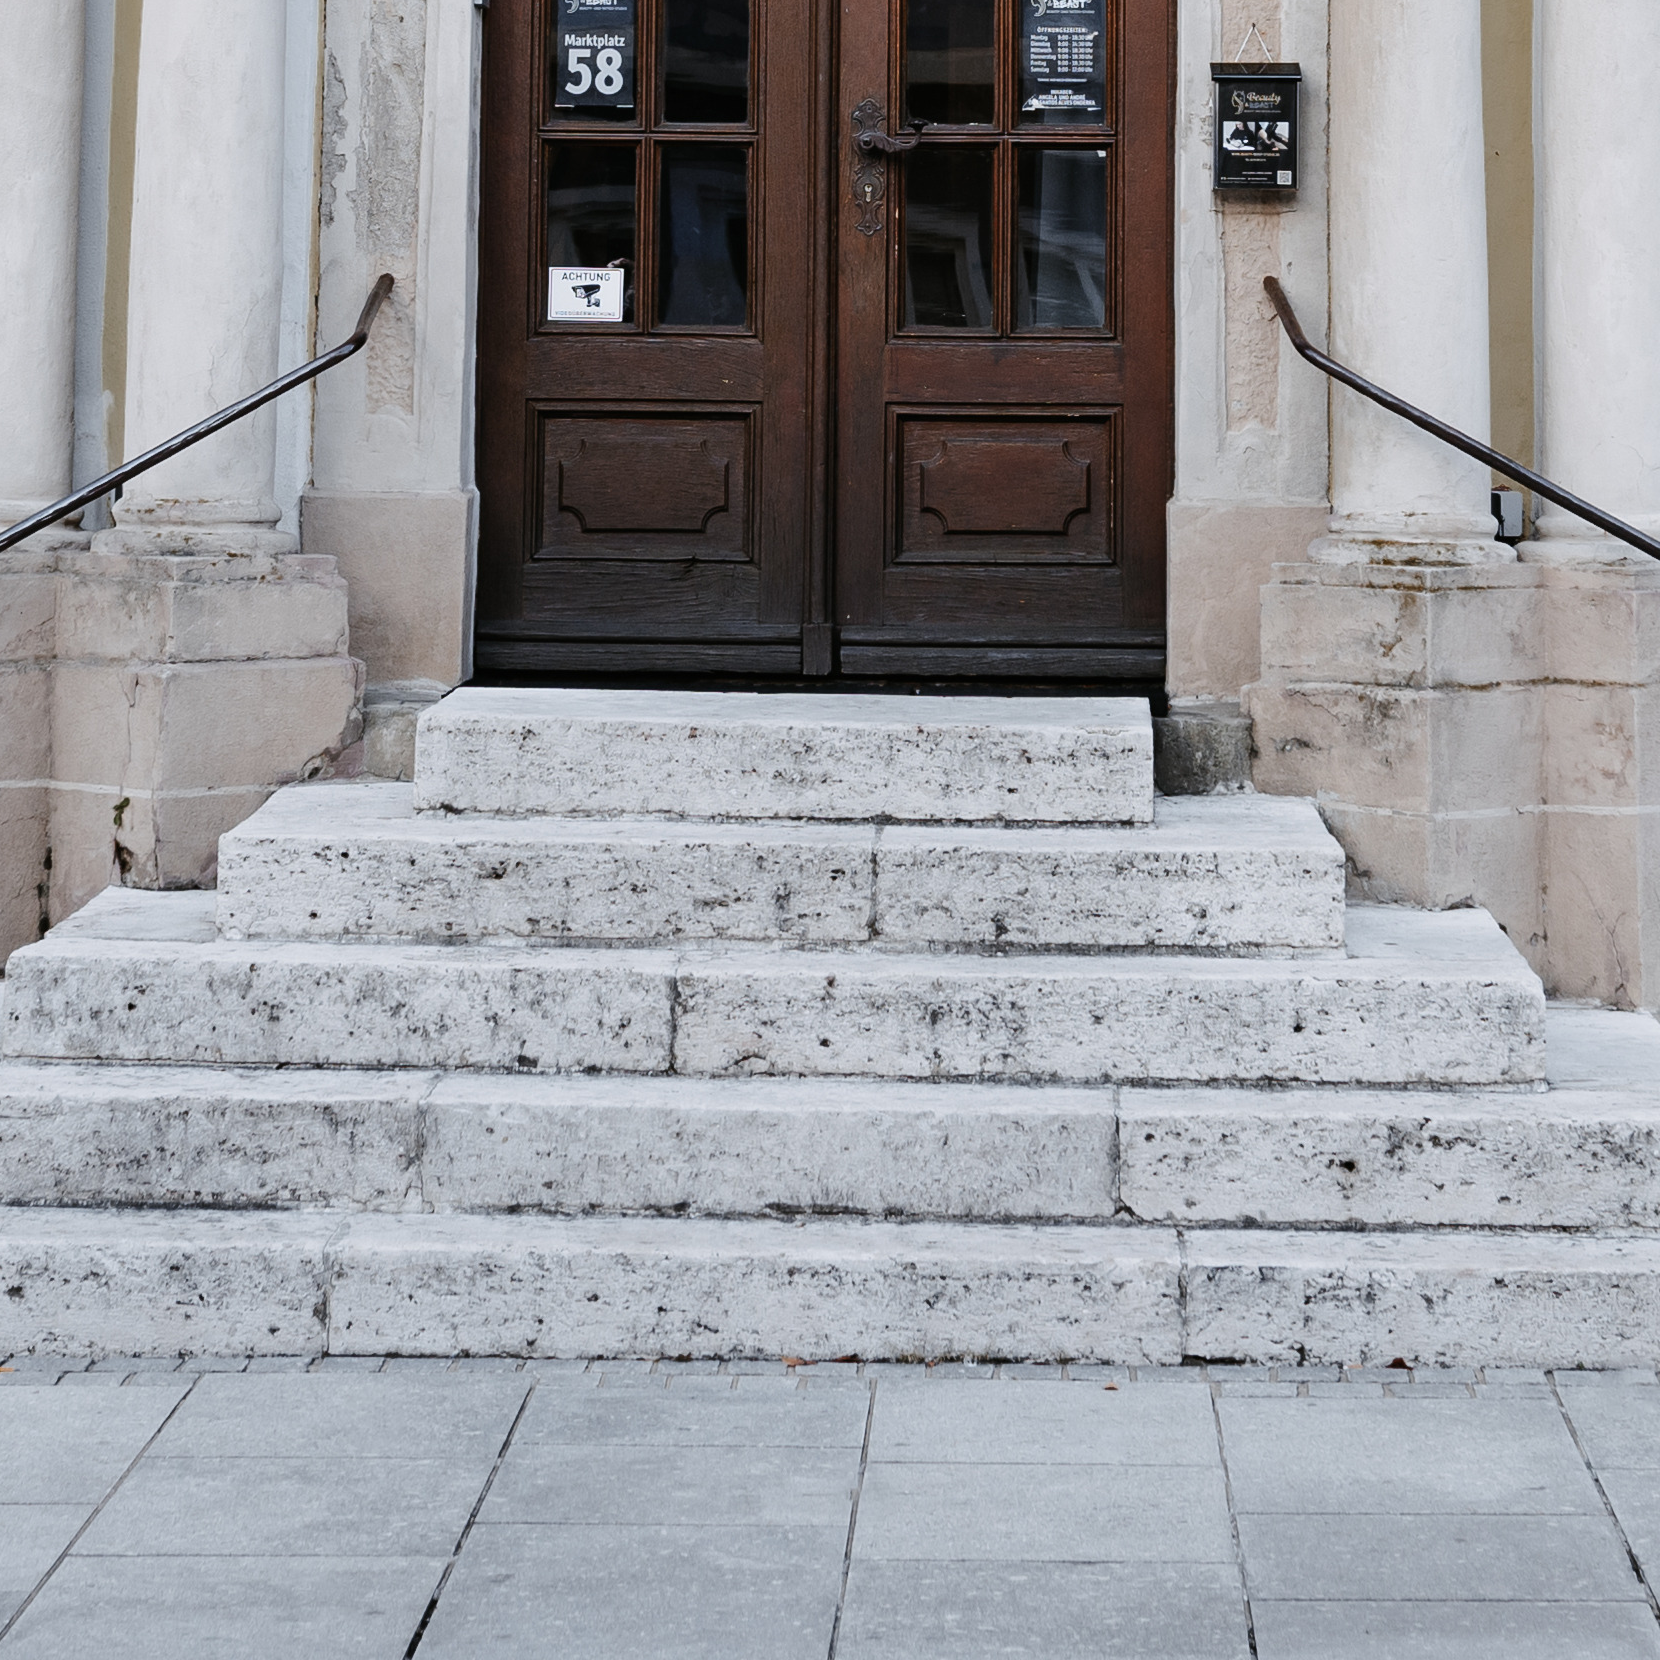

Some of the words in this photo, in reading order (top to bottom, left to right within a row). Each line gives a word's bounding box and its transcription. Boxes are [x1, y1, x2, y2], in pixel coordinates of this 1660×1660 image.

[564, 34, 626, 49] Marktplatz
[564, 48, 624, 95] 58
[561, 272, 611, 282] ACHTUNG
